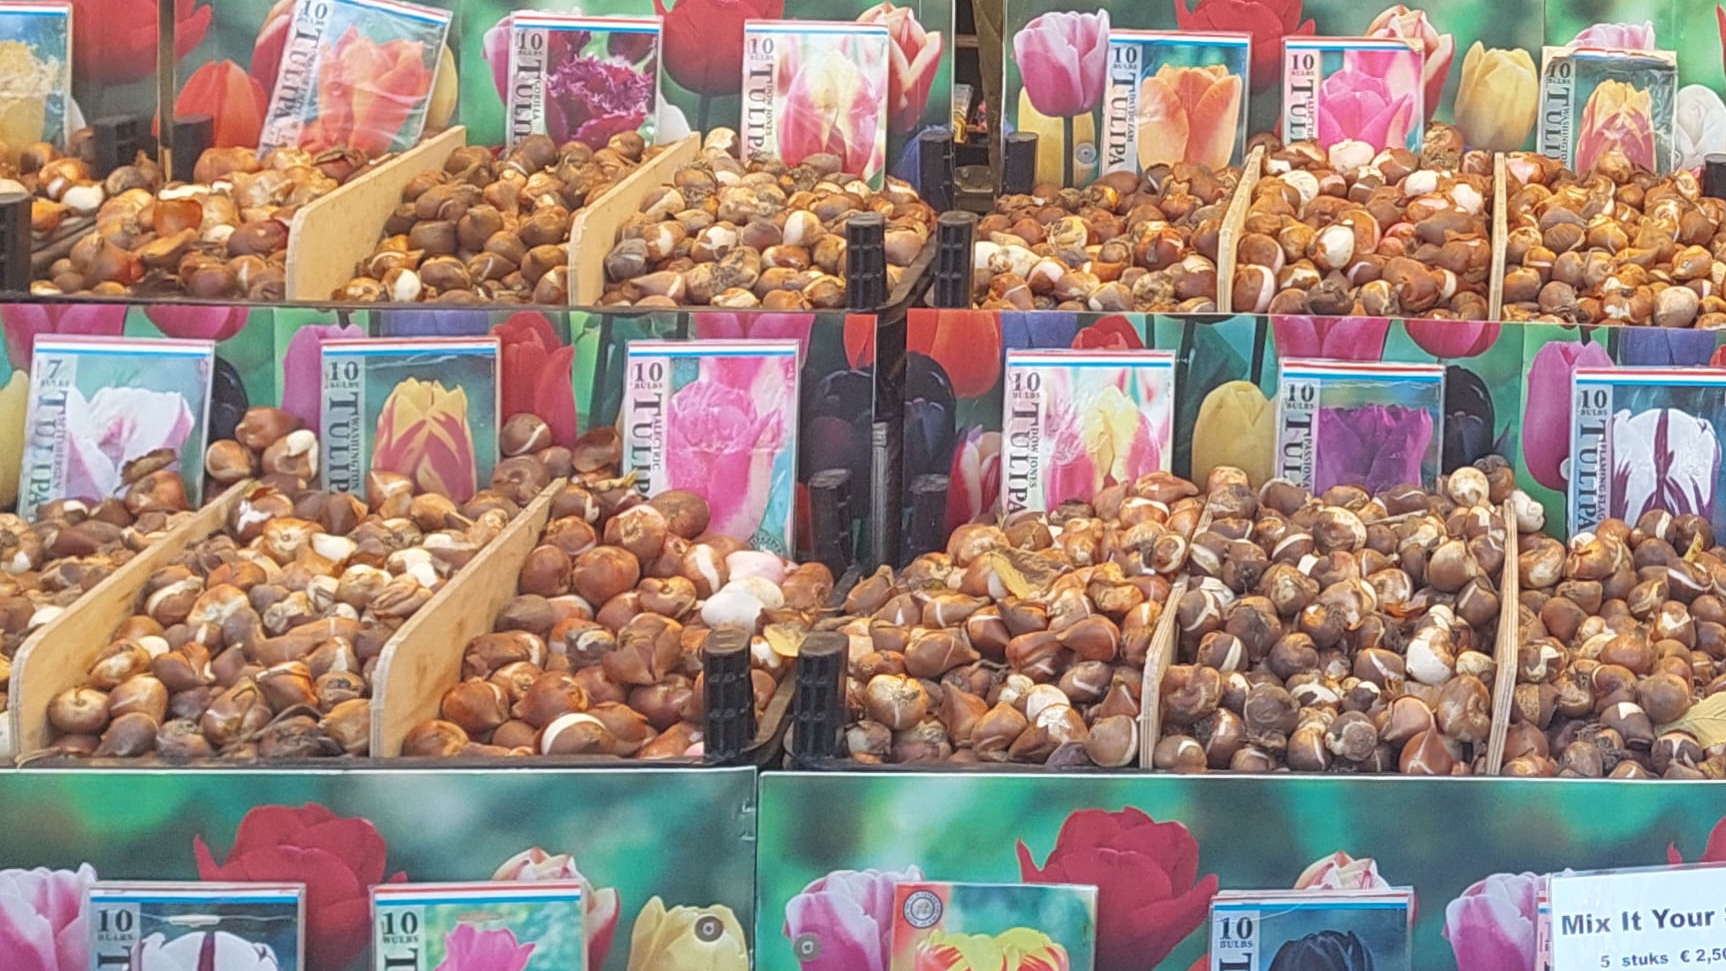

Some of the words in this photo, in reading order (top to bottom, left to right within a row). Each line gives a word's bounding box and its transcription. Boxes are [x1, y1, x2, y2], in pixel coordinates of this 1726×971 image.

[517, 32, 544, 50] 10
[751, 38, 775, 55] 10
[1114, 46, 1138, 63] 10
[1292, 54, 1315, 70] 10
[273, 28, 321, 121] TULIPA
[1548, 63, 1571, 80] 10
[1107, 72, 1137, 168] TULIPA
[48, 359, 63, 380] 7
[330, 361, 359, 381] 10
[634, 362, 663, 382] 10
[1013, 372, 1041, 392] 10
[1287, 384, 1315, 403] 10
[1581, 390, 1608, 410] 10
[28, 389, 69, 507] TULIPA
[1030, 426, 1041, 453] DOW
[349, 416, 360, 490] WASHINGTON
[1006, 401, 1041, 515] TULIPA
[1027, 456, 1039, 489] JONES
[1577, 419, 1607, 532] TULIPA
[1597, 443, 1608, 492] FLAMING
[97, 909, 133, 933] 10
[382, 912, 418, 935] 10
[1219, 917, 1253, 940] 10
[1561, 913, 1611, 935] Mix
[1622, 911, 1642, 932] It
[1652, 908, 1715, 930] Your
[1219, 939, 1254, 949] BULBS
[1600, 955, 1611, 969] 5
[1622, 951, 1670, 967] stuks
[1680, 949, 1690, 963] €
